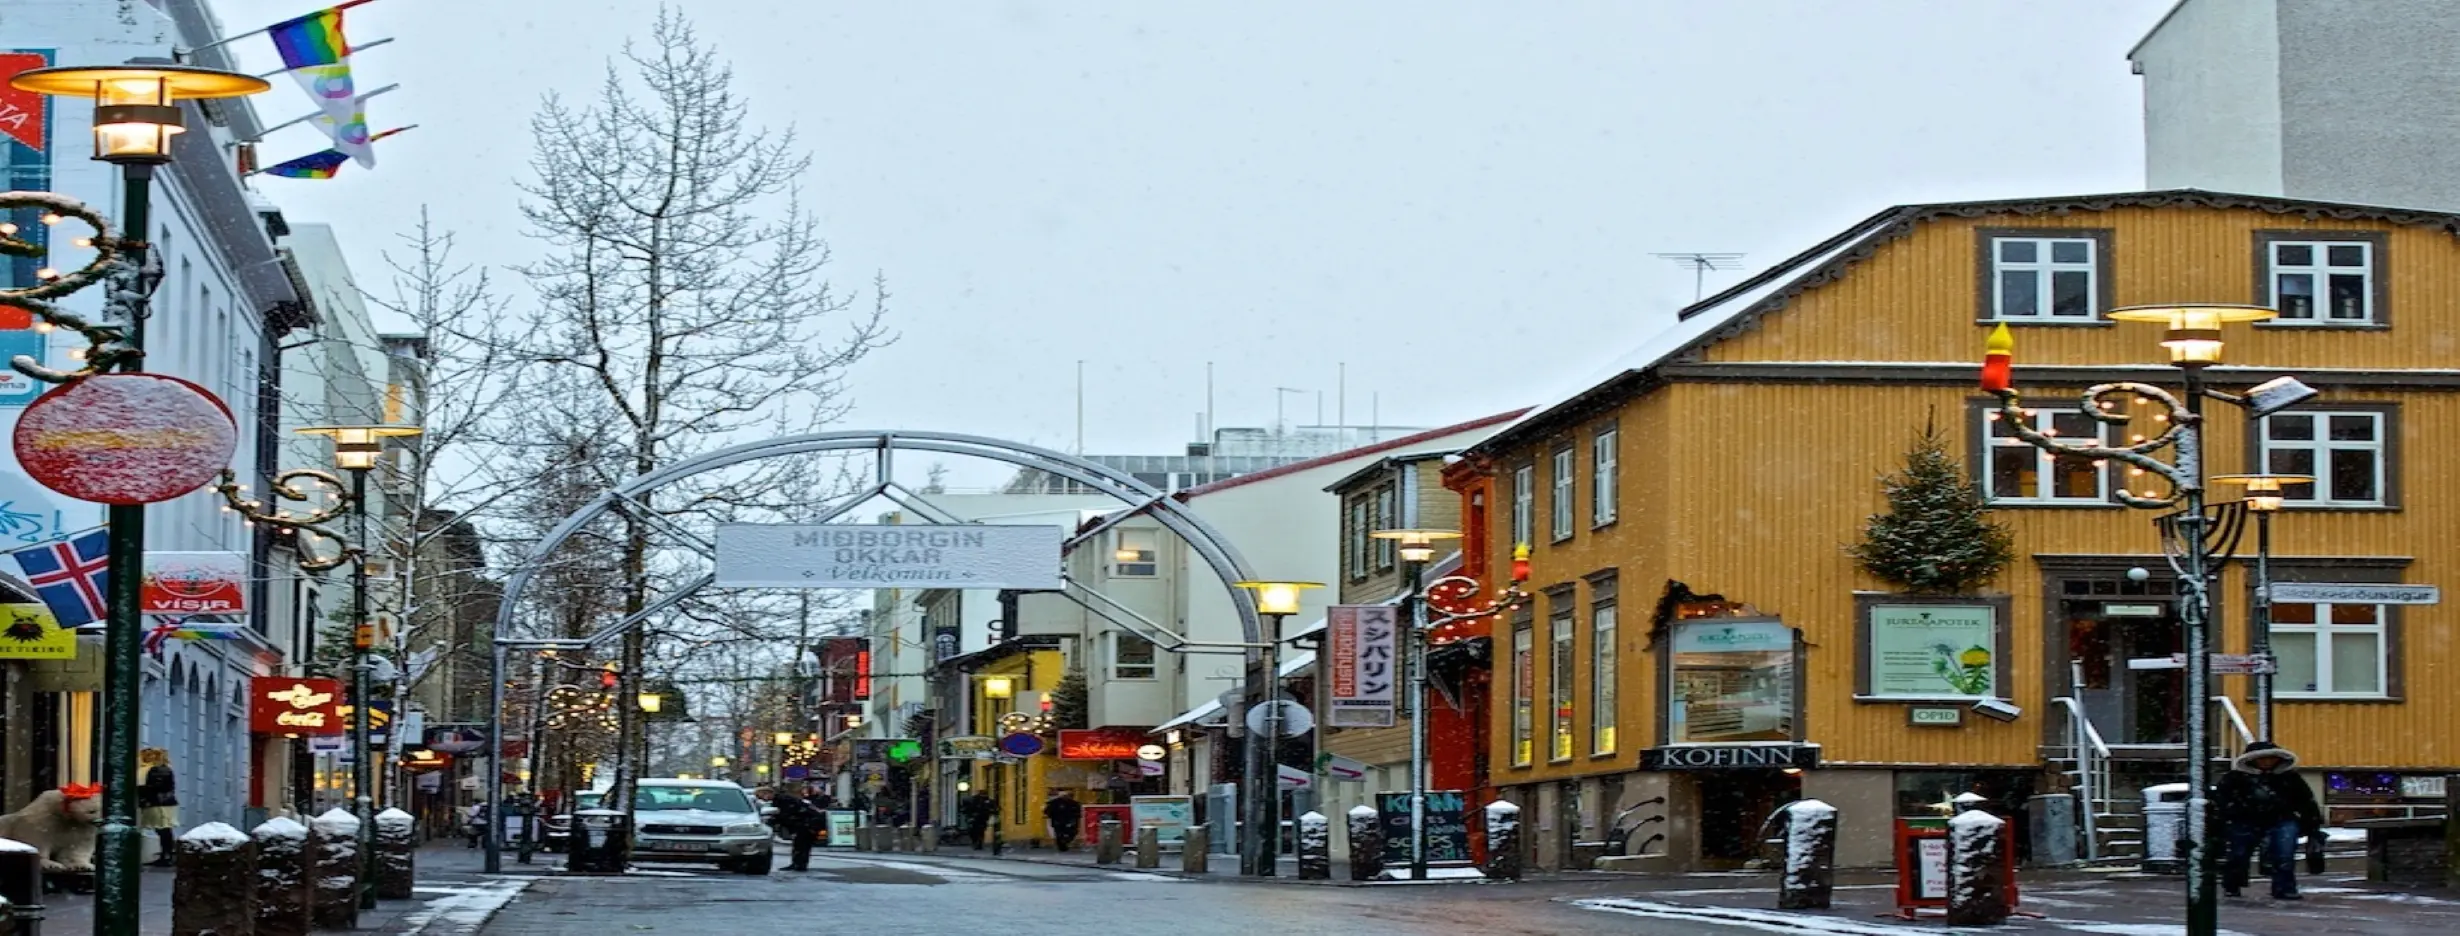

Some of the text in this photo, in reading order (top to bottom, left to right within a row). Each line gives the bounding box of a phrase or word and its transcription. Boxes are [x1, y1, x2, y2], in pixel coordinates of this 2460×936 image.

[793, 530, 984, 547] MIÐBORGIN
[834, 548, 942, 564] OKKAR
[825, 563, 951, 582] Velkomin
[153, 598, 230, 609] VÍSIR
[1662, 748, 1792, 766] KOFINN
